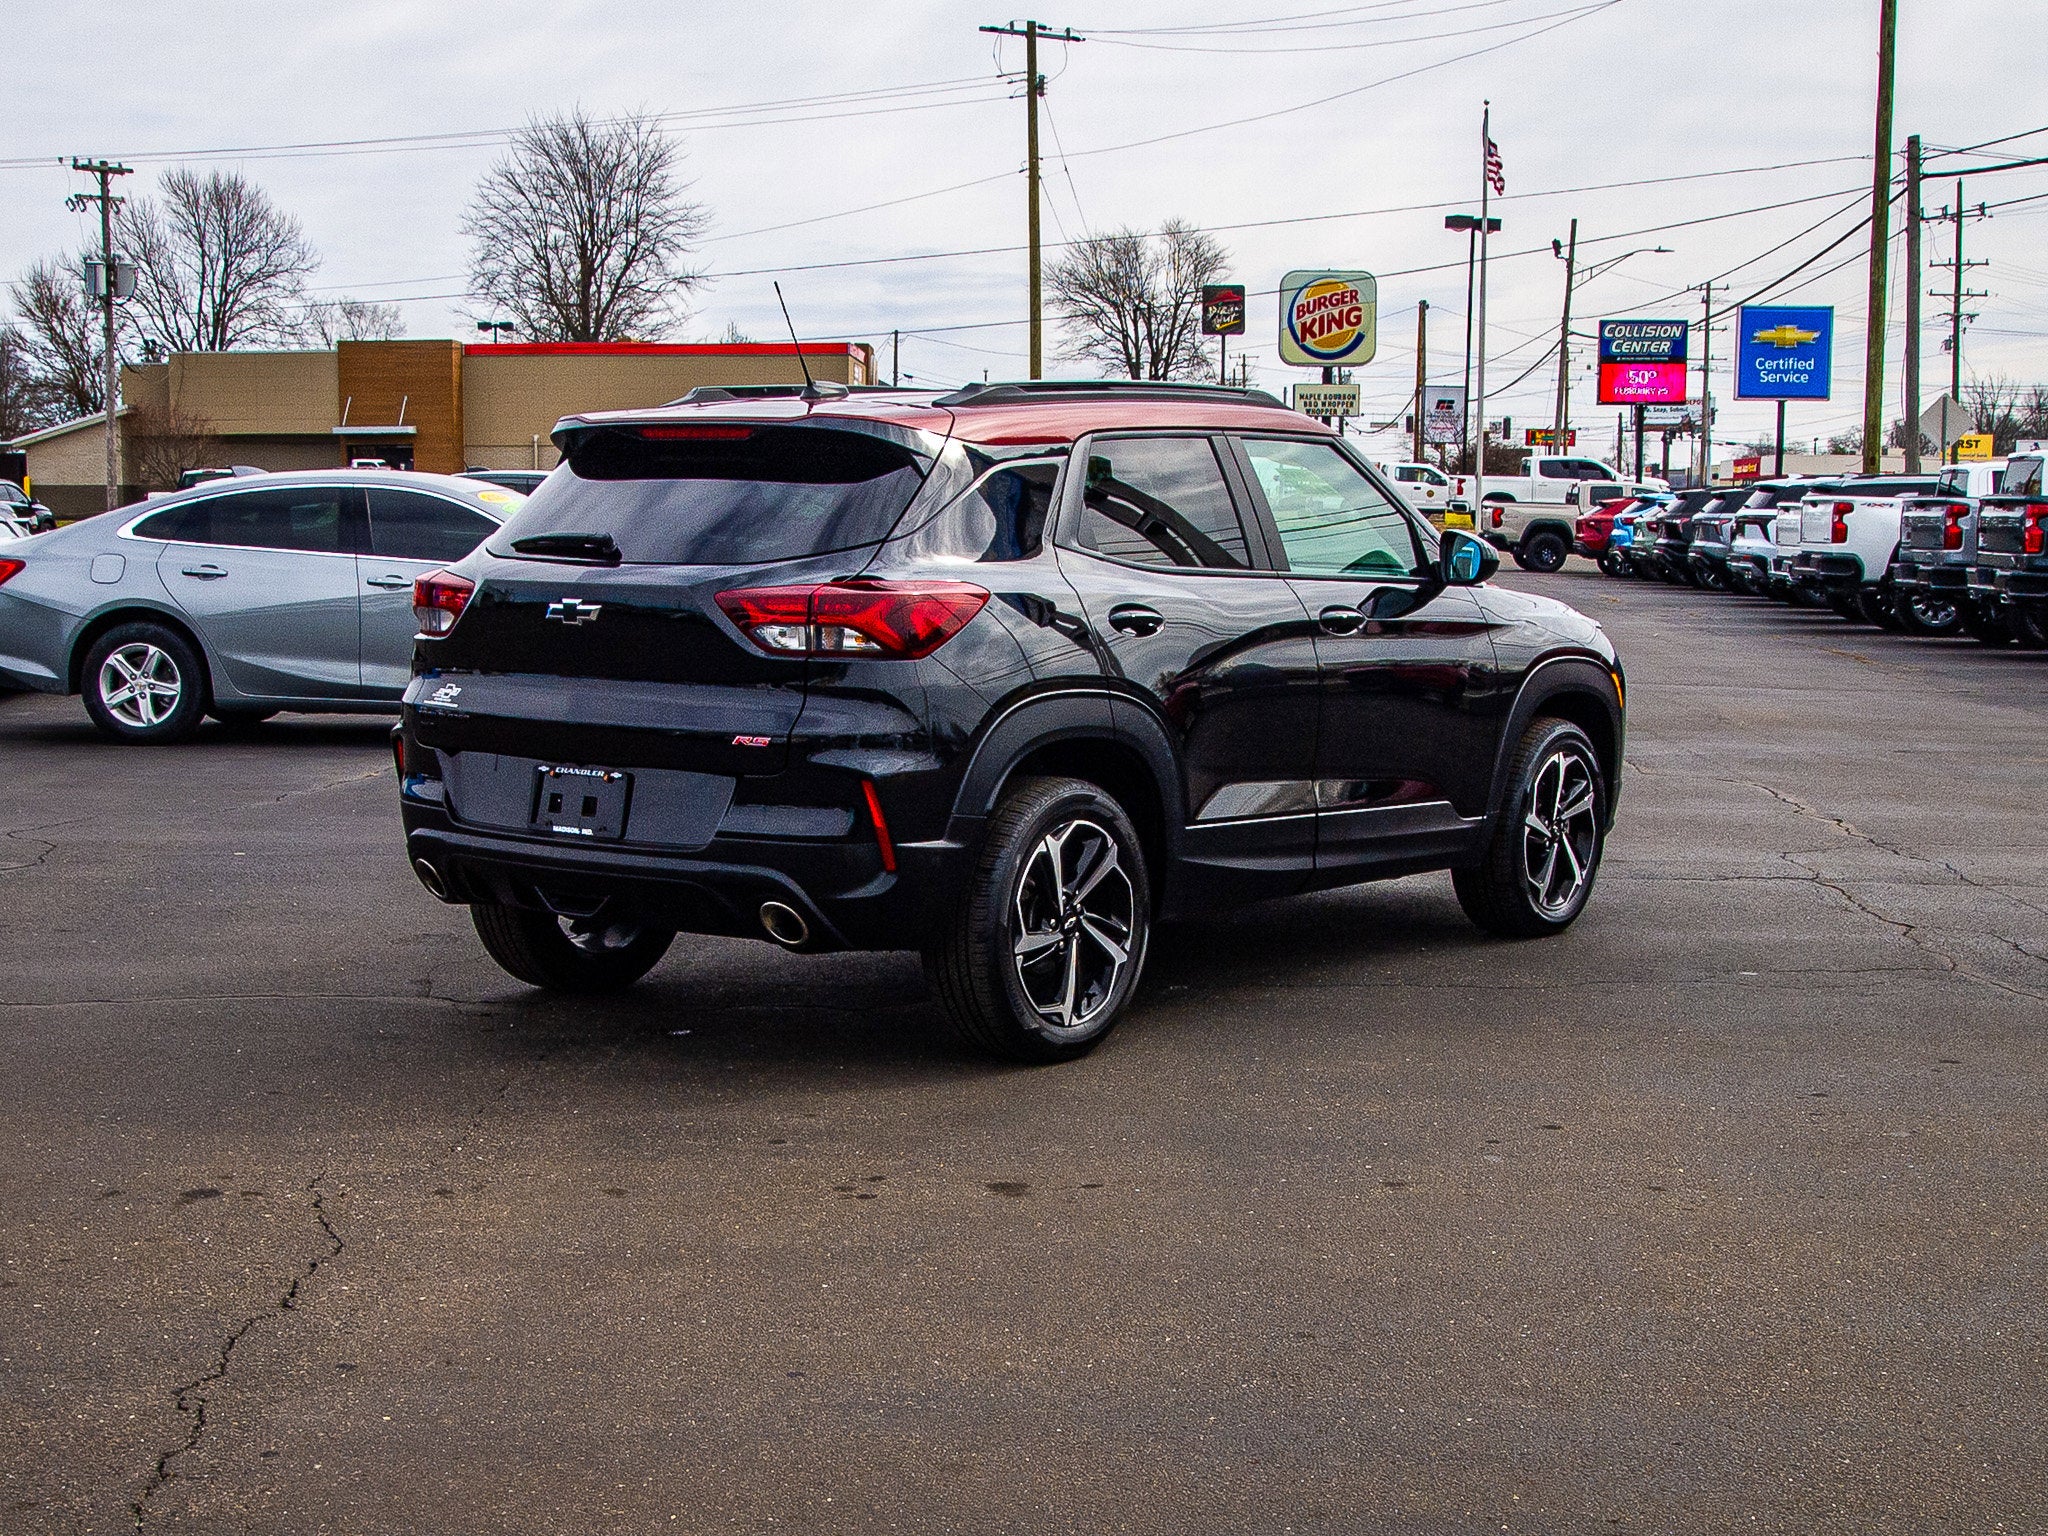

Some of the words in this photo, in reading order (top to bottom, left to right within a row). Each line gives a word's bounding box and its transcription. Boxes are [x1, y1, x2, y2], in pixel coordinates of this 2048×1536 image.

[1296, 289, 1360, 321] BURGER
[1300, 305, 1363, 344] KING
[1603, 324, 1683, 338] COLLISION
[1611, 339, 1671, 353] CENTER
[1755, 357, 1815, 370] Certified
[1759, 370, 1809, 383] Service
[1321, 400, 1354, 408] WHOPPER
[732, 735, 771, 747] RS
[555, 766, 605, 777] CHANDLER
